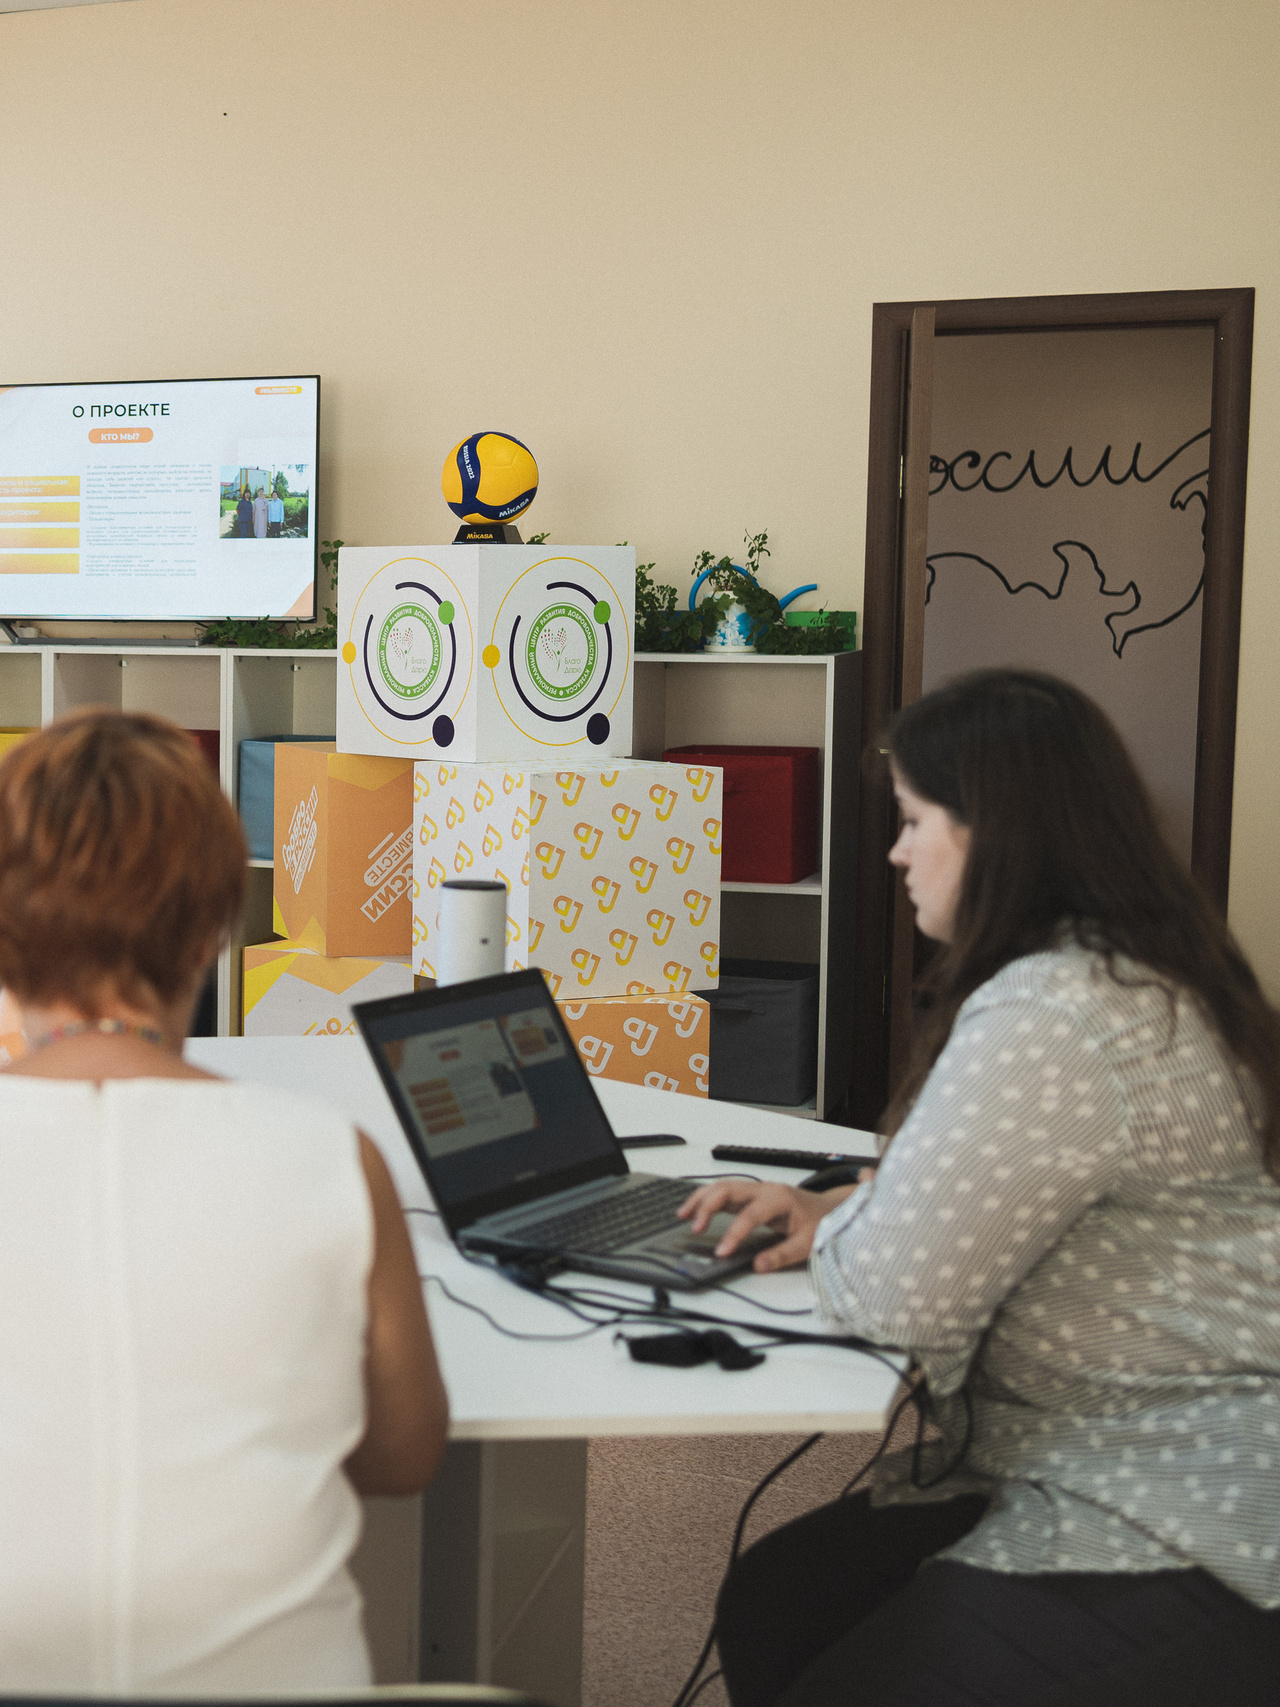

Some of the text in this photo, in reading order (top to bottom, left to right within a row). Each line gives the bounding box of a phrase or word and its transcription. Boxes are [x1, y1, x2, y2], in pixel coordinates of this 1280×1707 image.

[72, 403, 170, 418] О ПРОЕКТЕ
[100, 432, 140, 441] КТО МЫ?
[465, 464, 475, 480] 2022
[381, 625, 390, 646] ЦЕНТР
[530, 626, 540, 648] ЦЕНТР
